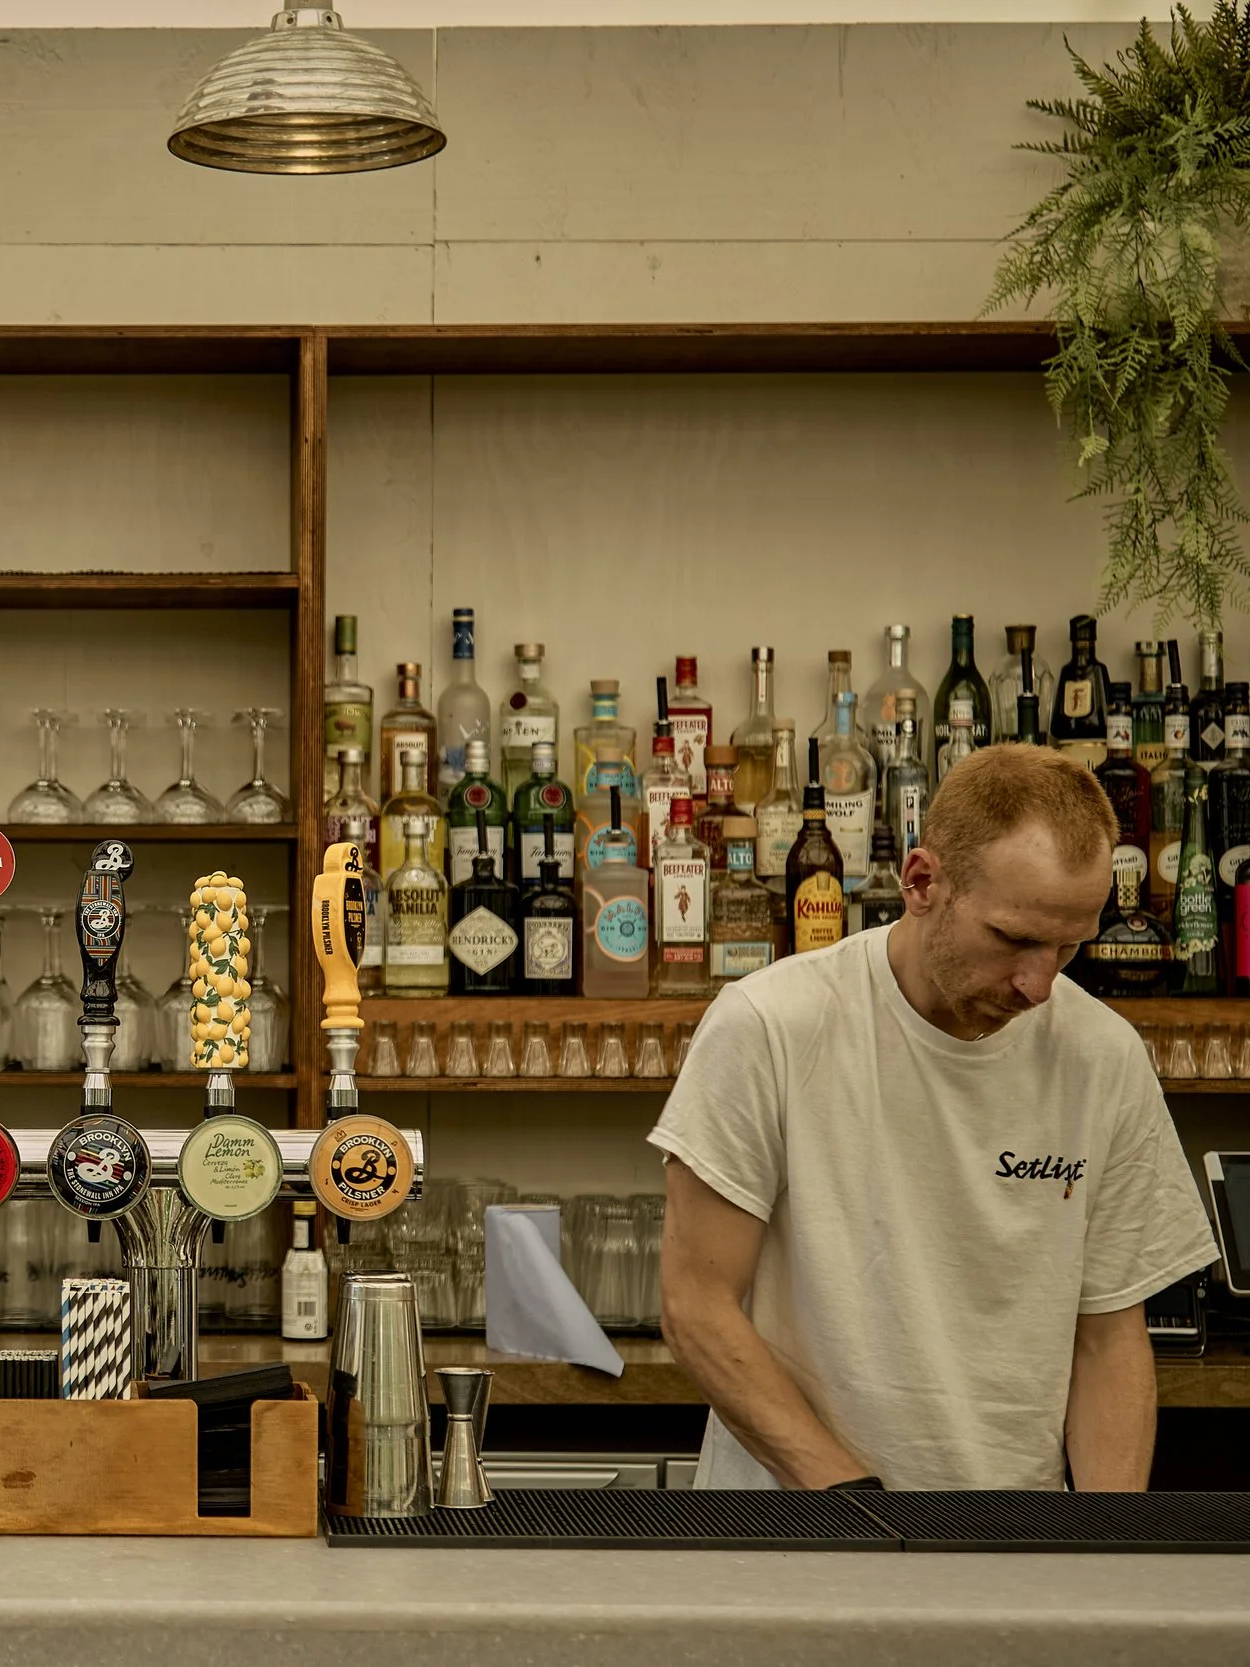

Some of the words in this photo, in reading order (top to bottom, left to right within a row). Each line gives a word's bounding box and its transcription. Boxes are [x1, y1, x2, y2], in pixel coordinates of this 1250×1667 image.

[516, 728, 539, 736] TEN
[826, 800, 863, 808] MILING
[826, 810, 855, 818] WOLF
[664, 864, 704, 876] BEEFEATER
[390, 889, 440, 901] ABSOLUT
[1180, 892, 1211, 905] bottle
[321, 900, 330, 930] BROOKLYN
[1180, 903, 1212, 916] green
[322, 931, 334, 955] PILSNER
[452, 935, 513, 945] HENDRICK'S
[79, 1132, 132, 1161] BROOKLYN
[212, 1133, 254, 1149] Damm
[339, 1136, 392, 1158] BROOKLYN
[205, 1142, 250, 1158] Lemon
[995, 1151, 1087, 1183] SetList
[67, 1168, 75, 1180] THE
[71, 1177, 101, 1200] STONEWALL
[102, 1191, 114, 1199] INN
[113, 1185, 124, 1195] IPA
[338, 1182, 386, 1200] PILSNER
[341, 1196, 359, 1207] CRISP
[361, 1199, 382, 1208] LAGER
